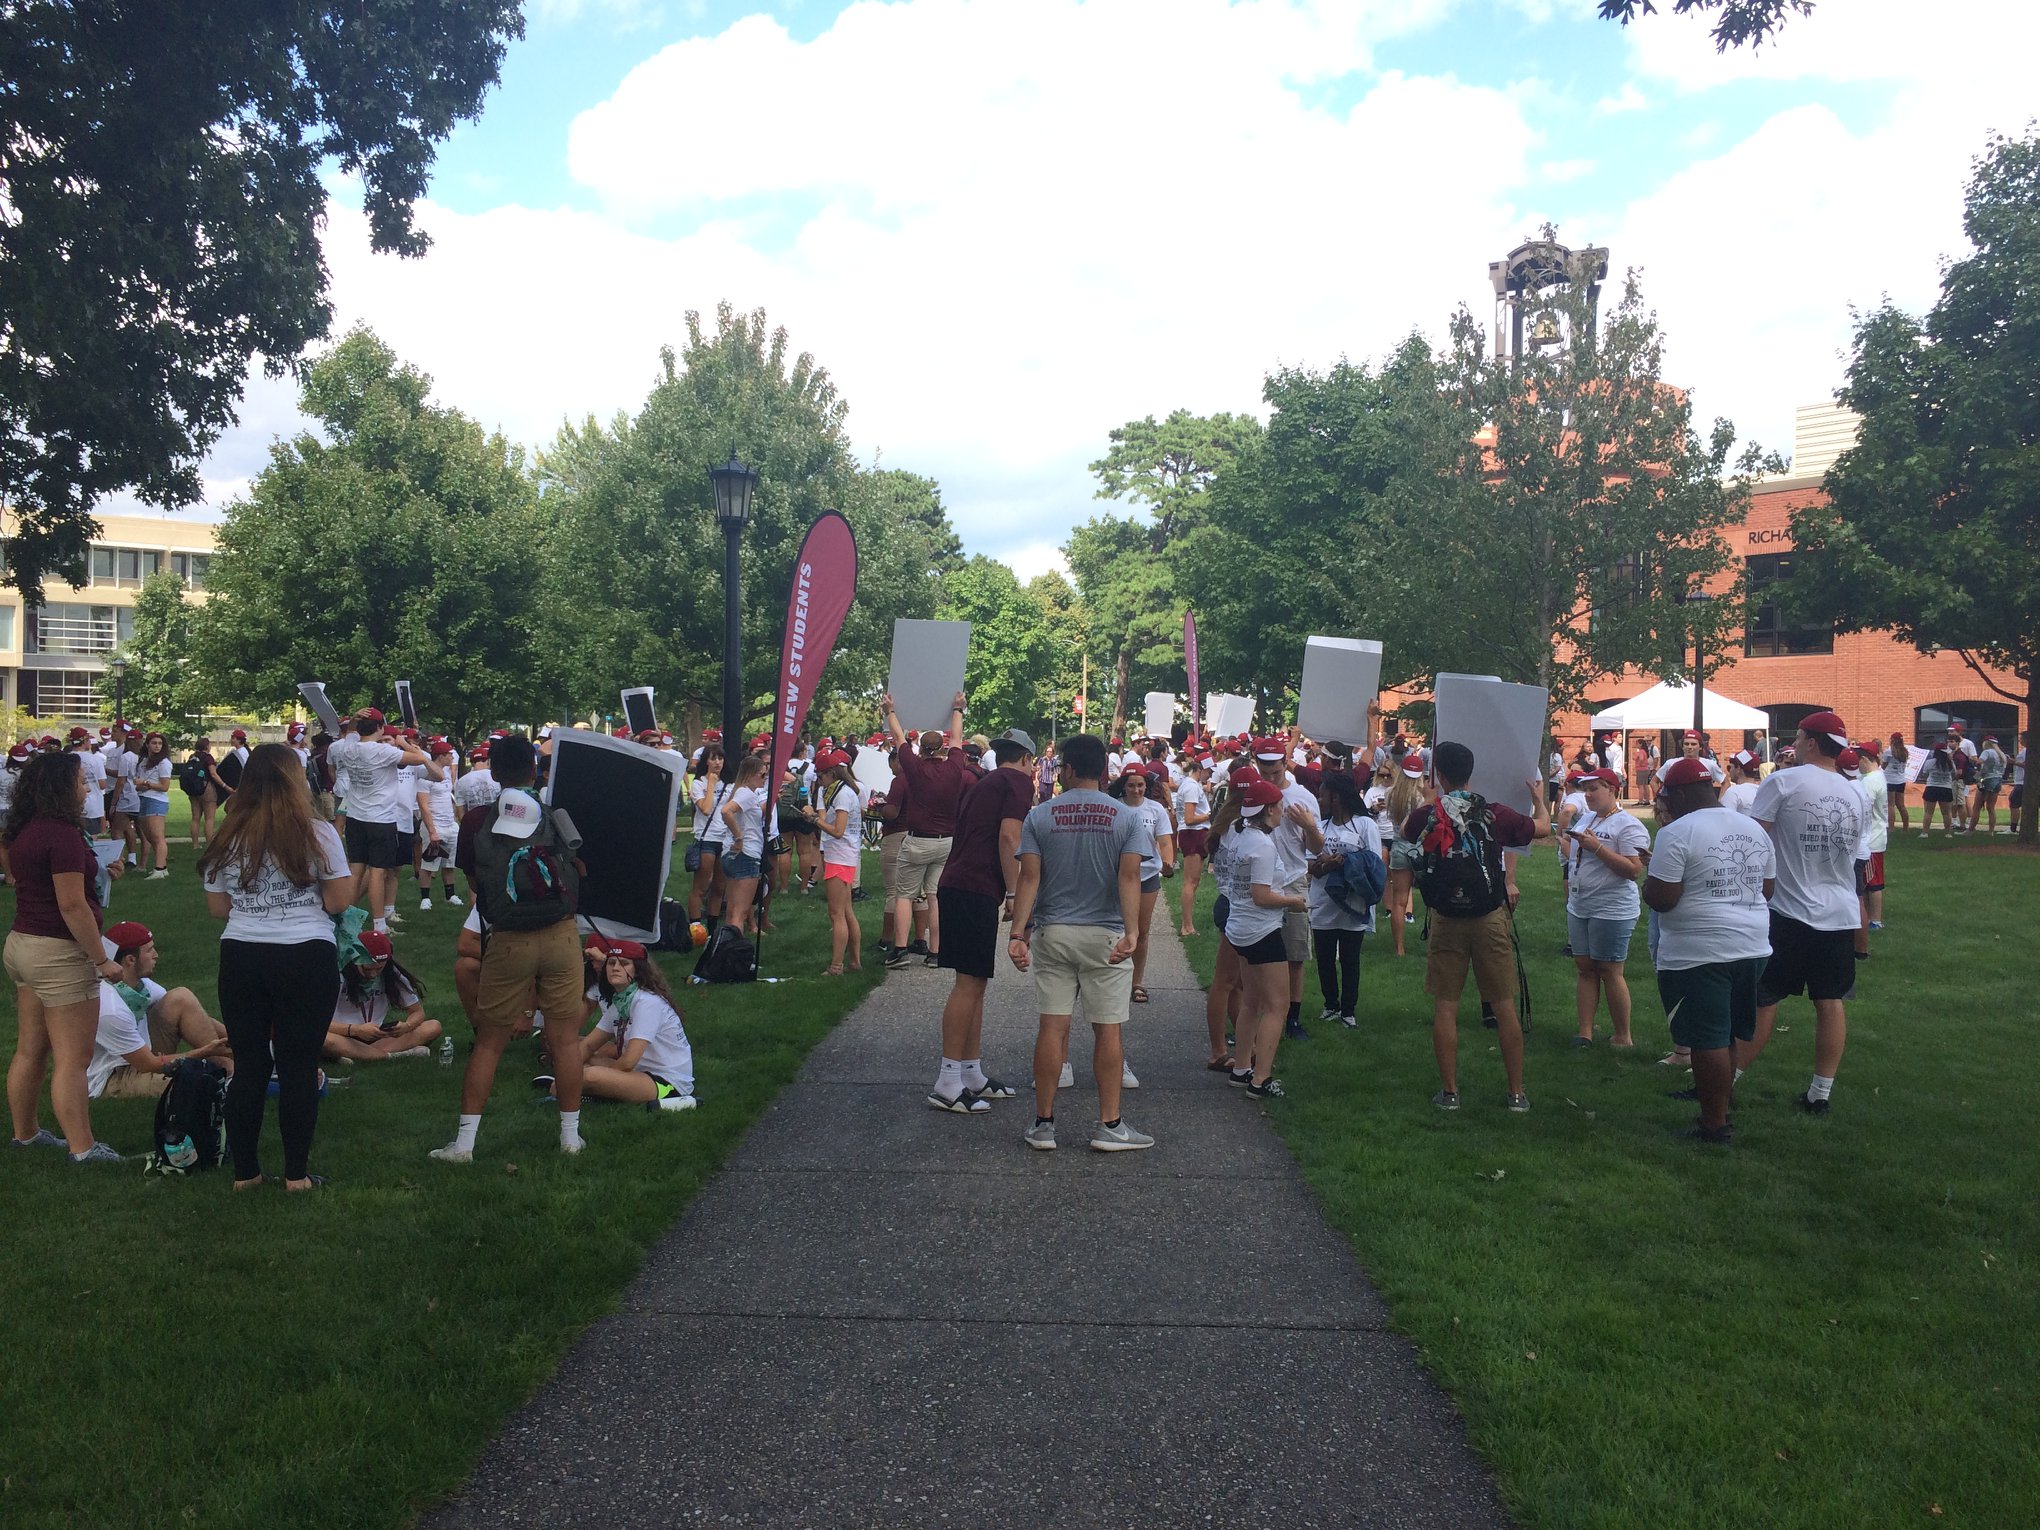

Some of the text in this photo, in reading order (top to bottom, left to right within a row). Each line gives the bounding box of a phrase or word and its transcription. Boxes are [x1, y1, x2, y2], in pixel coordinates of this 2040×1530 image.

[1748, 529, 1796, 544] RICHA
[784, 562, 812, 734] NEW STUDENTS
[1819, 796, 1834, 804] NSO
[1051, 803, 1118, 817] PRIDE SQUAD
[1055, 815, 1113, 827] VOLUNTEER
[1736, 834, 1753, 843] 2019
[270, 894, 285, 904] THE
